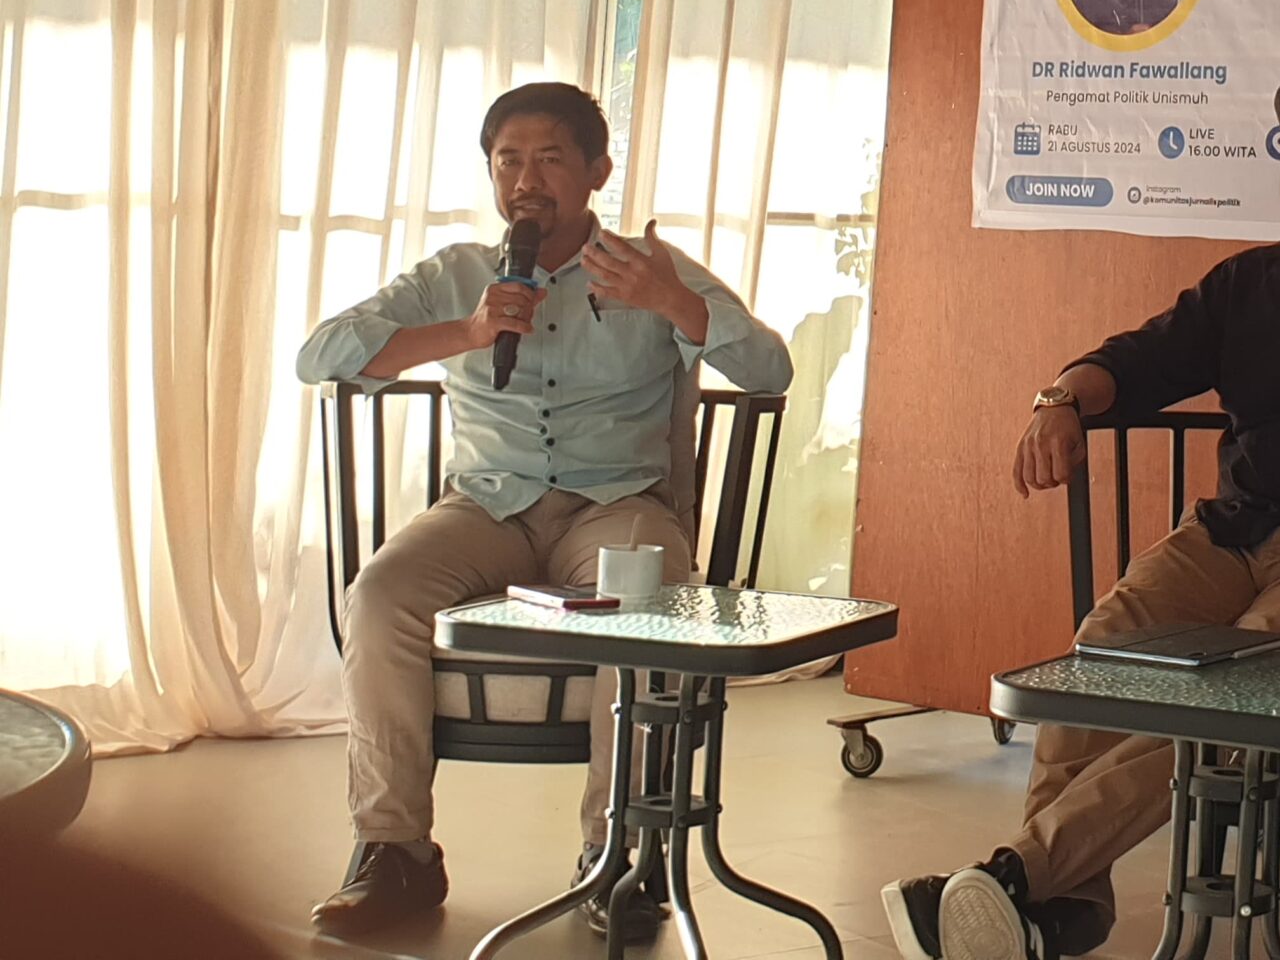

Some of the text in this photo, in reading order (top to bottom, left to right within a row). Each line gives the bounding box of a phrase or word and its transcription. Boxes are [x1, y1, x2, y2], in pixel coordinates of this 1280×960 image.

[1031, 61, 1228, 85] DR Ridwan Fawallang
[1046, 90, 1209, 107] Pengamat Politik Unismuh
[1047, 123, 1078, 136] RABU
[1189, 128, 1215, 140] LIVE
[1047, 140, 1141, 154] 21 AGUSTUS 2024
[1188, 145, 1257, 158] 16.00 WITA
[1025, 183, 1095, 198] JOIN NOW
